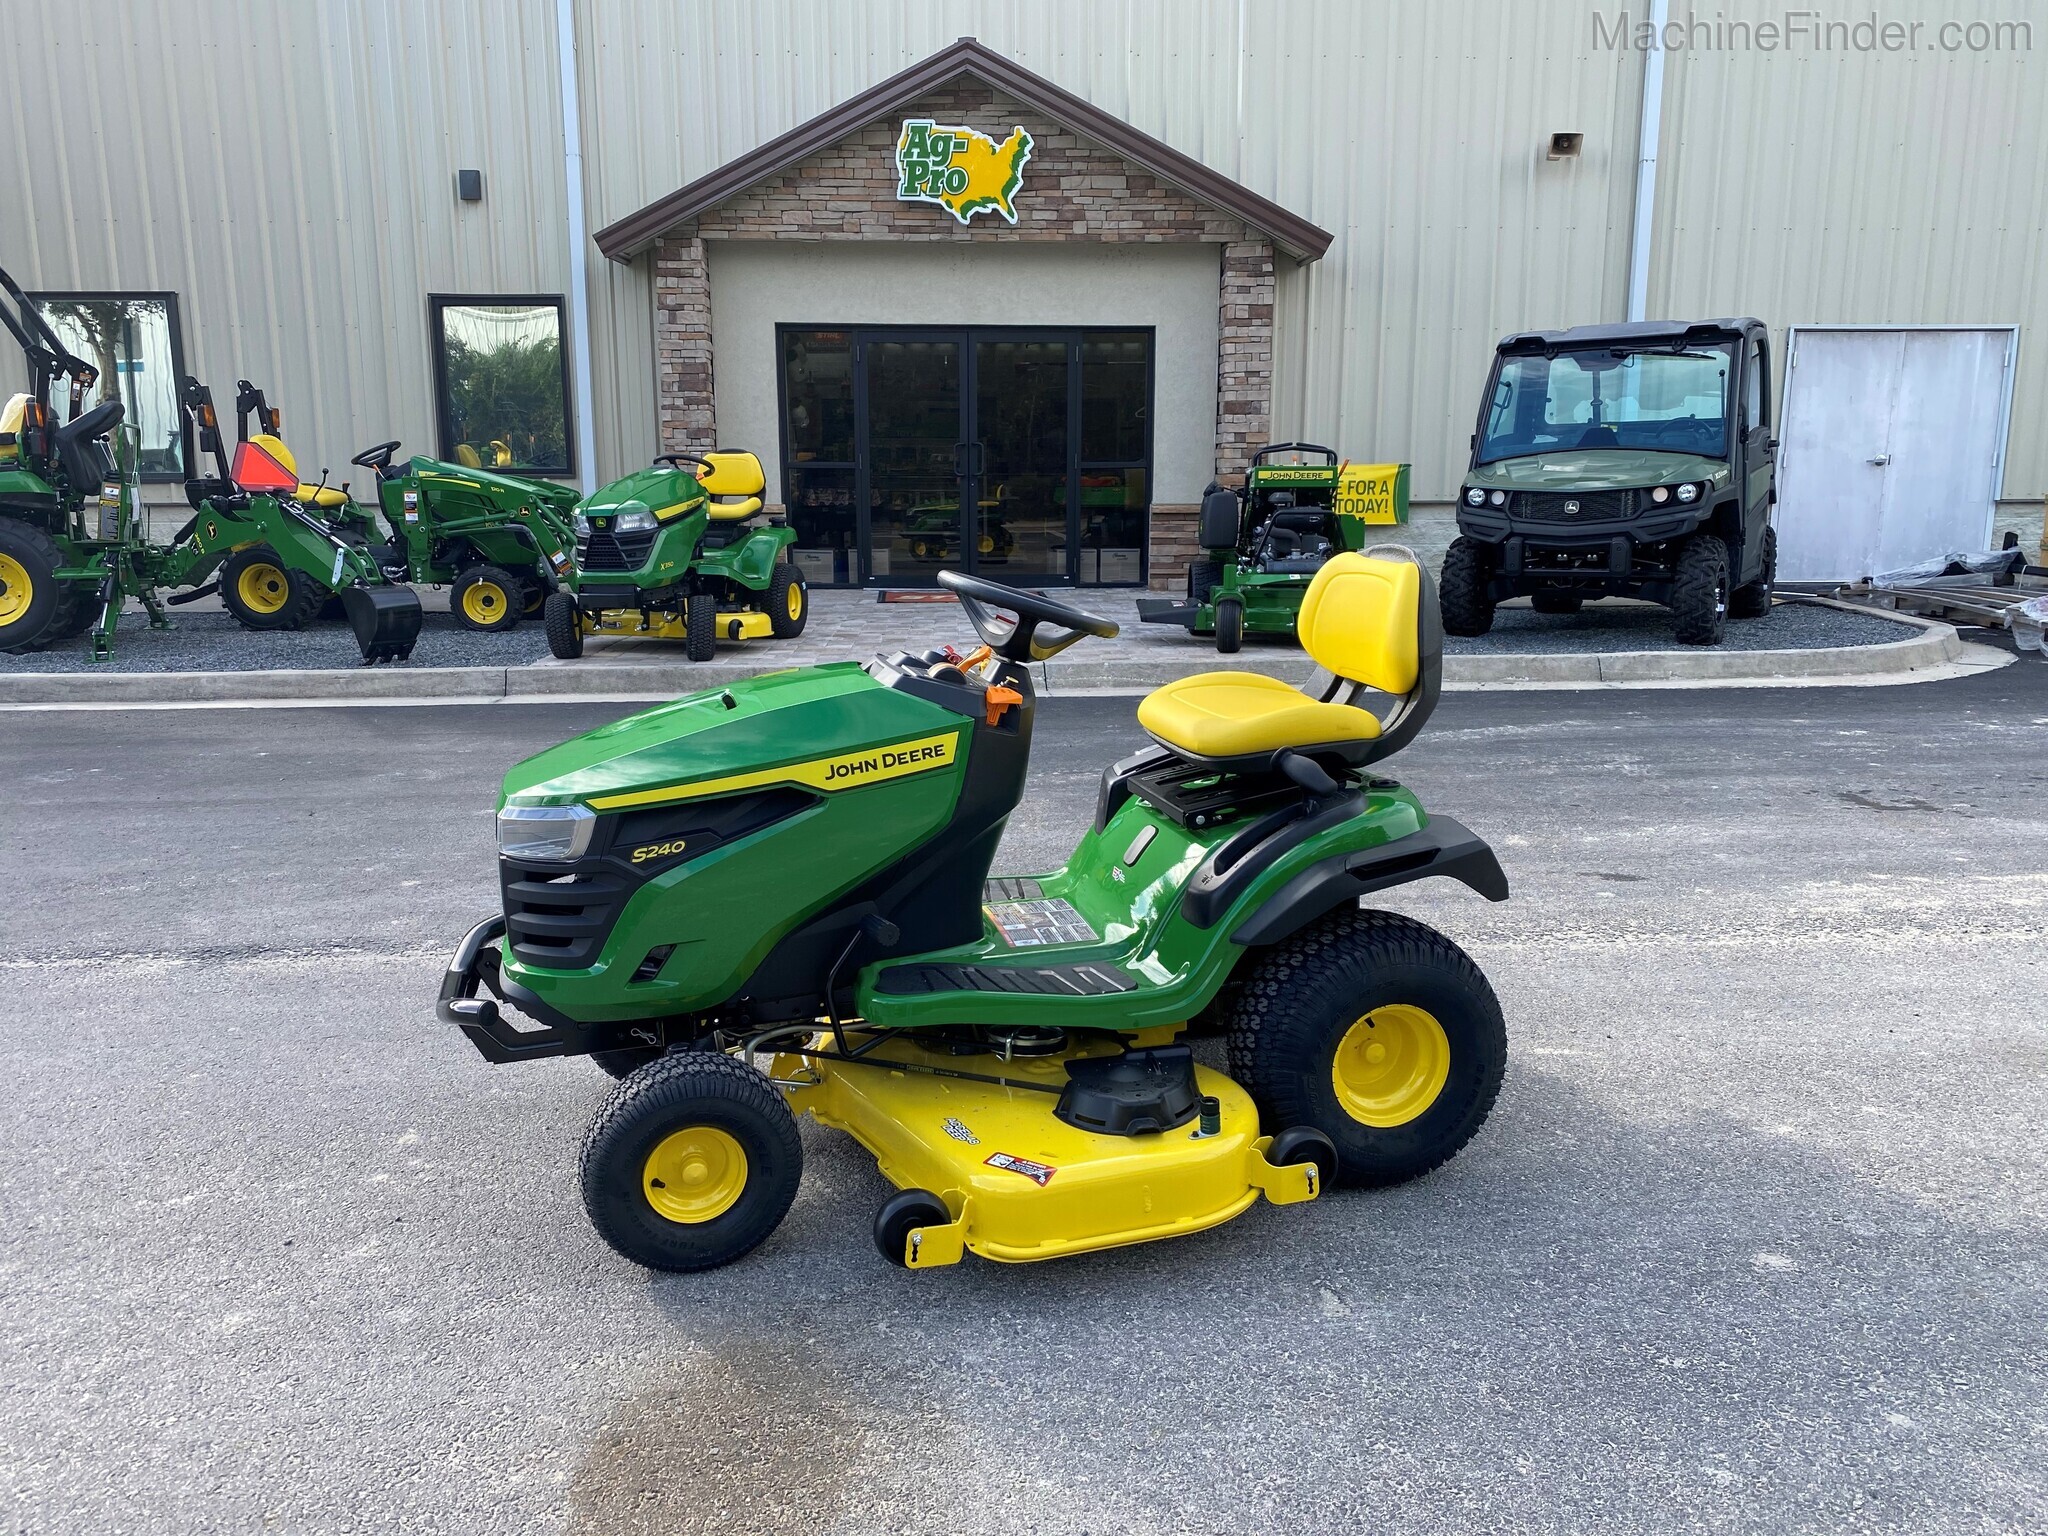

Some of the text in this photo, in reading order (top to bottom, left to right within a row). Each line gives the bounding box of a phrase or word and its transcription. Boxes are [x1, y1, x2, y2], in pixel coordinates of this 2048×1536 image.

[901, 123, 968, 167] Ag-
[901, 159, 969, 196] Pro
[1267, 471, 1324, 480] JOHN DEERE
[1347, 480, 1377, 495] FOR
[1379, 480, 1390, 495] A
[1337, 498, 1389, 514] TODAY!
[660, 561, 674, 571] X350
[825, 744, 946, 781] JOHN DEERE
[631, 840, 686, 863] S240
